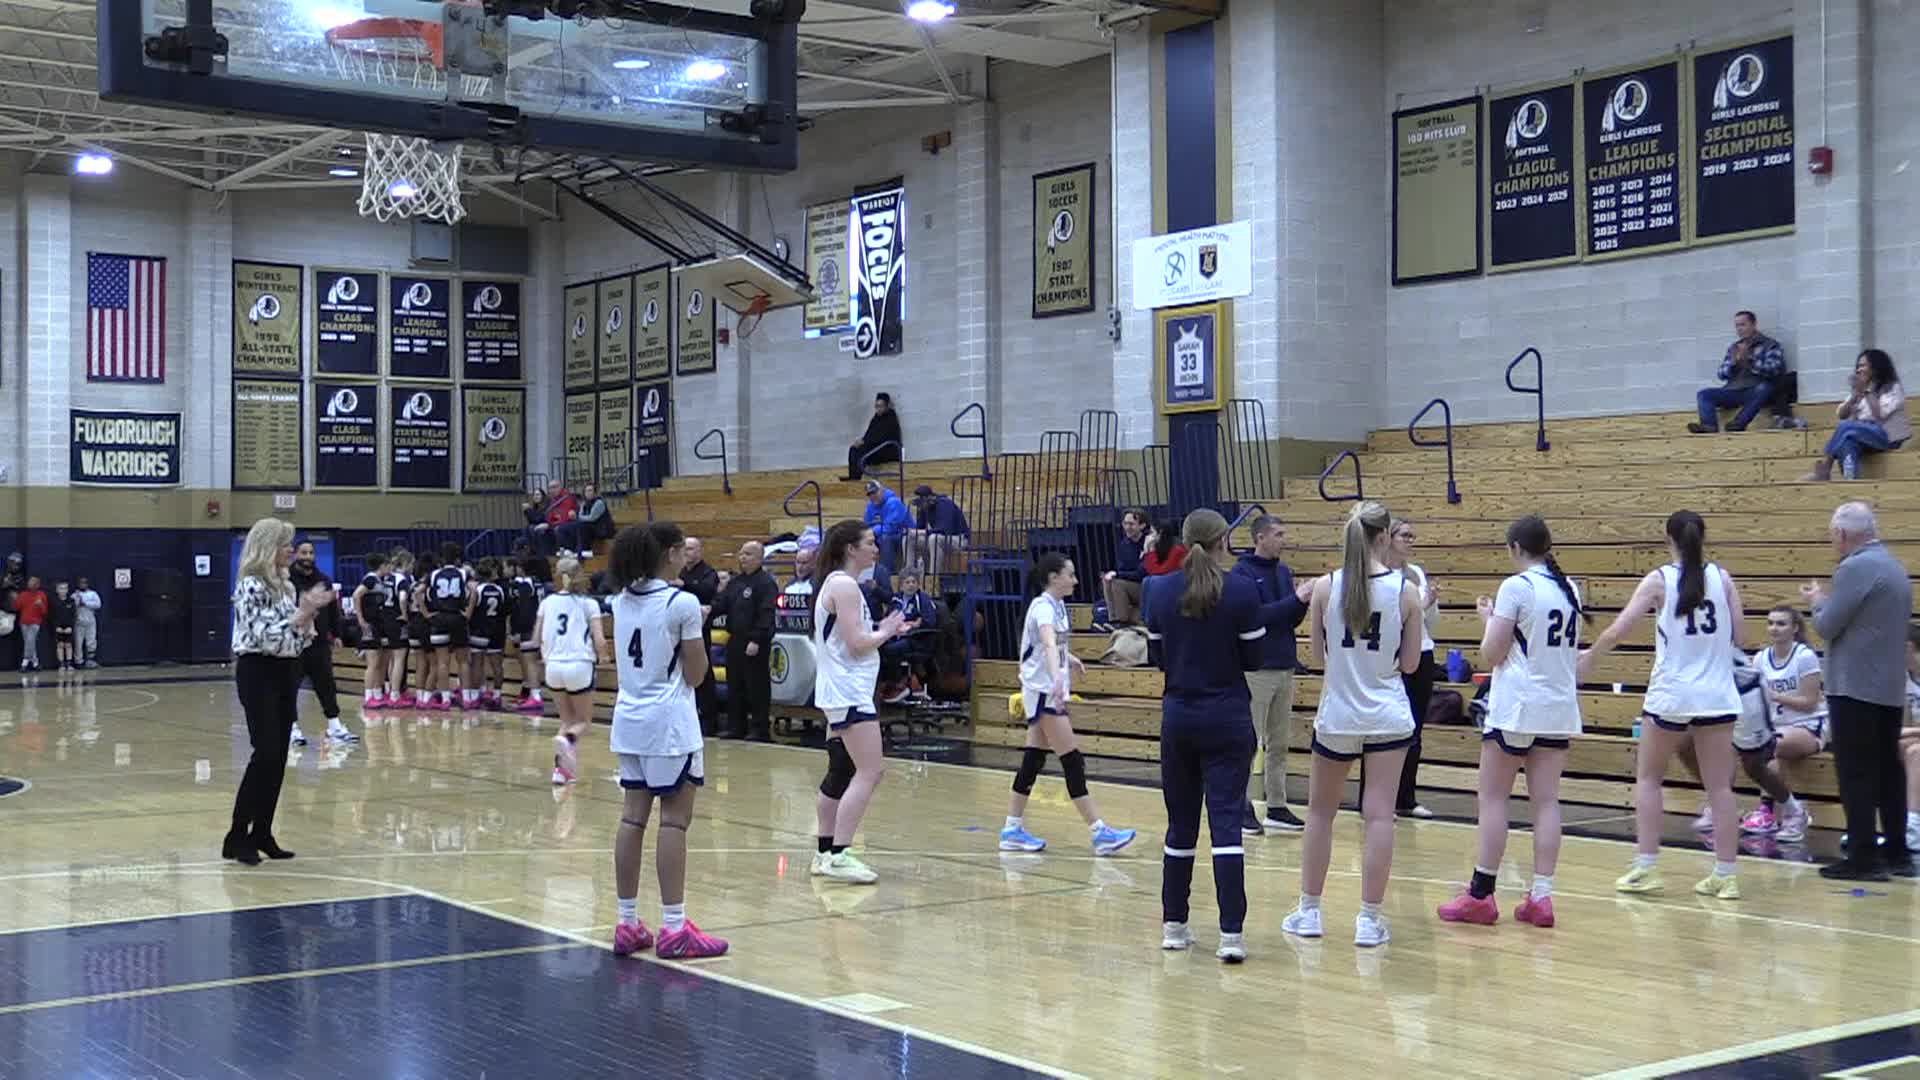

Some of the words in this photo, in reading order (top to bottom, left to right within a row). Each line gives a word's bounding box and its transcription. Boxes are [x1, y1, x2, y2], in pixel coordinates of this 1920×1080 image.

[1737, 100, 1779, 116] LACROSSE
[1418, 113, 1456, 128] SOFTBALL
[1704, 115, 1788, 142] SECTIONAL
[1408, 132, 1422, 144] 100
[1424, 129, 1442, 140] HITS
[1444, 125, 1466, 138] CLUB
[1600, 131, 1621, 144] GIRLS
[1623, 123, 1662, 138] LACROSSE
[1515, 144, 1549, 158] SOFTBALL
[1605, 139, 1658, 162] LEAGUE
[1701, 131, 1792, 160] CHAMPIONS
[1508, 158, 1556, 177] LEAGUE
[1588, 153, 1675, 180] CHAMPIONS
[1703, 163, 1726, 176] 2019
[1732, 158, 1758, 171] 2023
[1763, 153, 1790, 166] 2024
[1051, 180, 1075, 194] GIRLS
[1494, 171, 1569, 196] CHAMPIONS
[1592, 184, 1615, 196] 2012
[1621, 179, 1643, 191] 2013
[1649, 174, 1672, 186] 2014
[1048, 194, 1078, 208] SOCCER
[1521, 194, 1543, 206] 2024
[1593, 198, 1616, 210] 2015
[1621, 193, 1644, 204] 2016
[1650, 187, 1671, 199] 2017
[1593, 211, 1616, 224] 2018
[1621, 206, 1644, 218] 2019
[1650, 202, 1672, 214] 2021
[1594, 225, 1617, 238] 2022
[1622, 220, 1645, 232] 2023
[1649, 216, 1674, 228] 2024
[1594, 239, 1618, 251] 2025
[862, 209, 896, 301] FOCUS
[254, 271, 281, 281] GIRLS
[1049, 274, 1074, 288] STATE
[1037, 288, 1088, 305] CHAMPIONS
[334, 313, 362, 322] CLASS
[403, 318, 438, 328] LEAGUE
[320, 322, 376, 333] CHAMPIONS
[393, 327, 447, 337] CHAMPIONS
[465, 330, 518, 340] CHAMPIONS
[241, 342, 293, 353] ALL-STATE
[237, 355, 297, 366] CHAMPIONS
[1181, 353, 1197, 371] 33
[74, 416, 176, 446] FOXBOROUGH
[332, 425, 360, 434] CLASS
[319, 435, 375, 444] CHAMPIONS
[394, 437, 448, 447] CHAMPIONS
[81, 449, 170, 477] WARRIORS
[472, 463, 517, 473] ALL-STATE
[436, 577, 461, 598] 34
[485, 597, 499, 617] 2
[1684, 598, 1717, 635] 13
[556, 613, 569, 636] 3
[1342, 610, 1382, 651] 14
[1547, 608, 1577, 648] 24
[628, 628, 643, 668] 4
